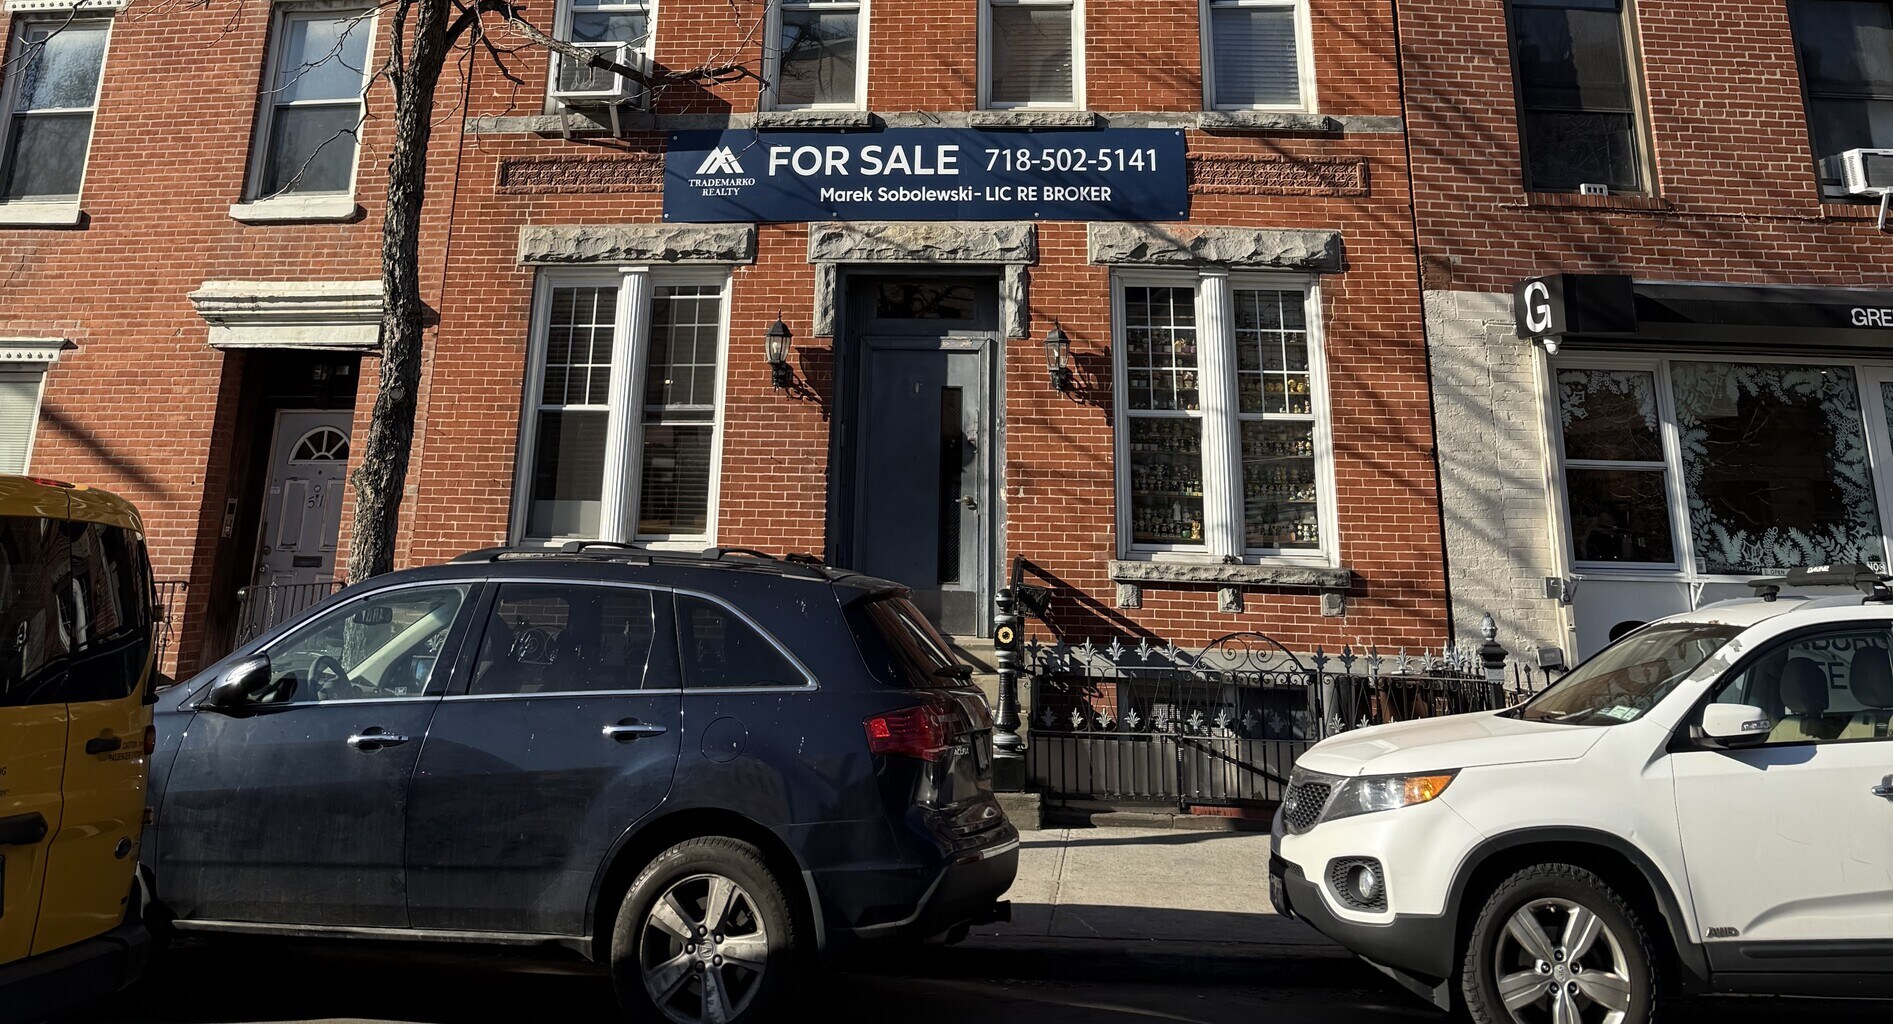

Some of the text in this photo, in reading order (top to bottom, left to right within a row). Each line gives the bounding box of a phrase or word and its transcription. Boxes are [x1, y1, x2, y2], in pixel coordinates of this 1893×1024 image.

[768, 144, 1157, 176] FOR SALE 718-502-5141
[688, 178, 755, 187] TRADEMARKO
[702, 188, 741, 196] REALTY
[820, 187, 873, 202] Marek
[986, 186, 1012, 201] LIC
[1017, 186, 1038, 201] RE
[1043, 186, 1112, 202] BROKER
[1524, 281, 1552, 333] G
[1850, 307, 1893, 327] GRE
[1705, 926, 1740, 938] AWD
